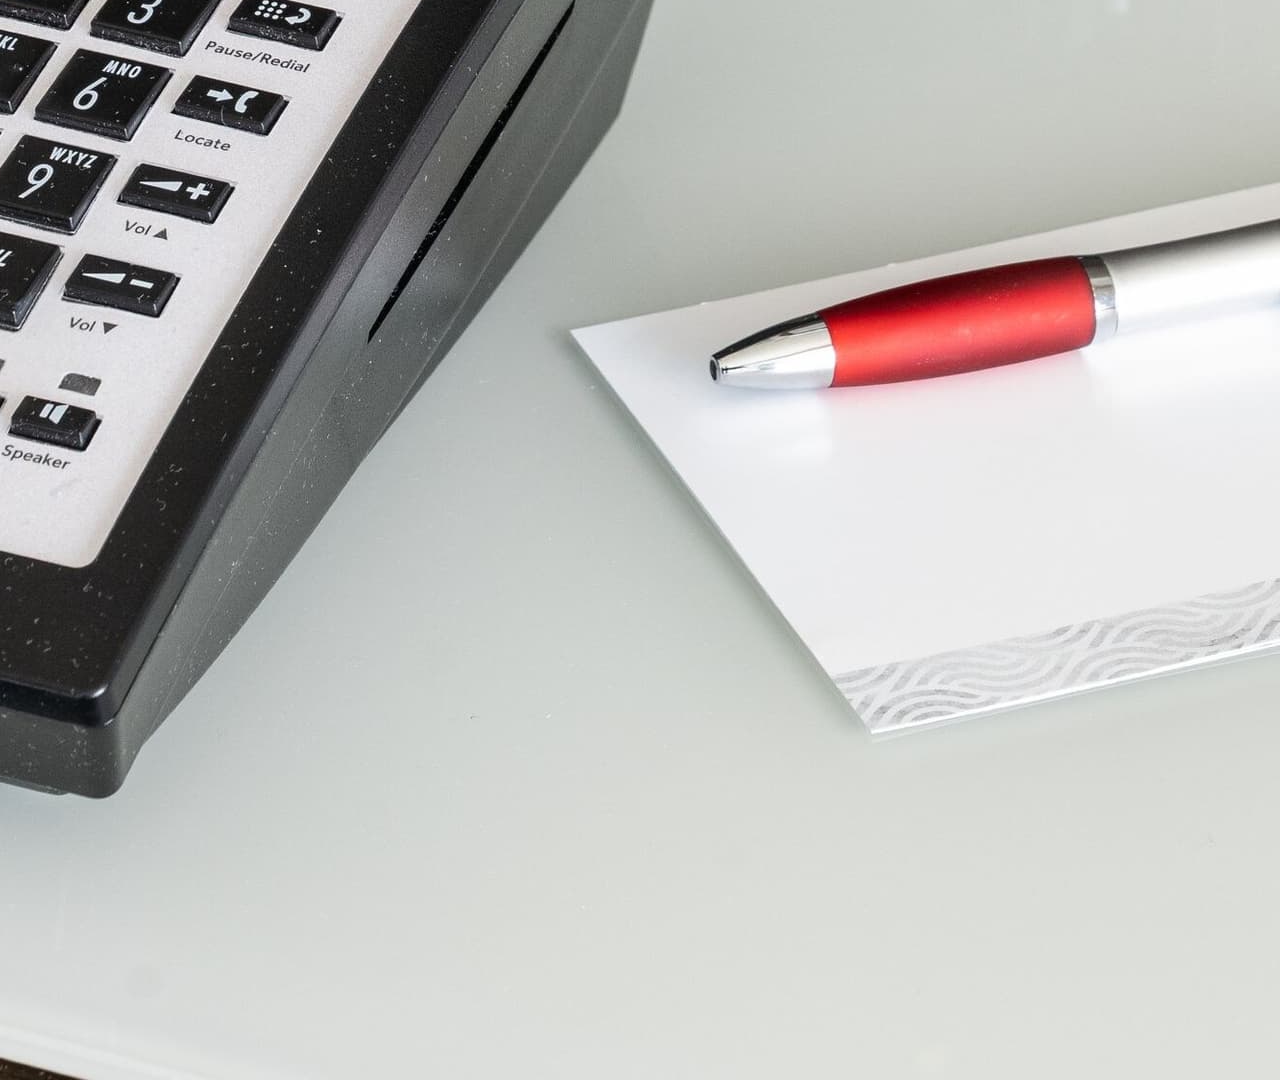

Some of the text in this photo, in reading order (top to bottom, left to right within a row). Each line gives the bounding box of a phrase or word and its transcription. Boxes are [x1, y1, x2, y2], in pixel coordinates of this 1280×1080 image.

[204, 40, 311, 73] Pause/Redial
[102, 59, 142, 79] MNO
[72, 76, 108, 111] 6
[174, 129, 232, 152] Locate
[49, 146, 98, 169] WXYZ
[17, 163, 54, 199] 9
[124, 220, 152, 236] Vol
[69, 317, 97, 332] Vol
[1, 444, 72, 470] Speaker
